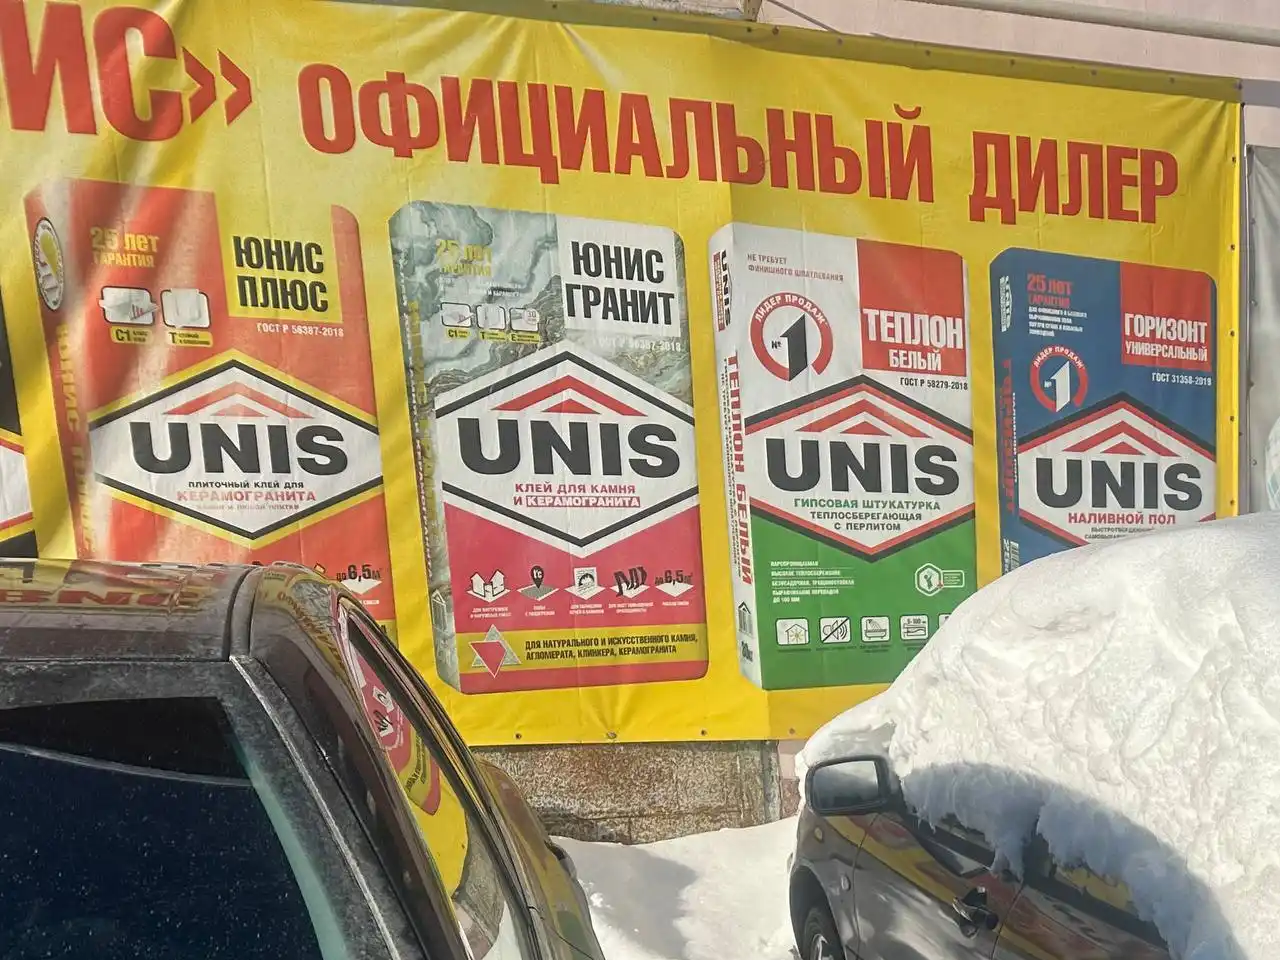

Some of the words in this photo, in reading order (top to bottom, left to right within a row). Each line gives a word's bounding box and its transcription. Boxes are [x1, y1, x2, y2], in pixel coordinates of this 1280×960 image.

[298, 63, 934, 203] ОФИЦИАЛЬНЫЙ
[968, 130, 1179, 225] ДИЛЕР
[232, 235, 325, 274] ЮНИС
[571, 241, 665, 283] ЮНИС
[758, 255, 787, 265] ТРЕБУЕТ
[748, 264, 793, 275] ФИНИШНОГО
[237, 276, 329, 312] ПЛЮС
[565, 283, 676, 325] ГРАНИТ
[754, 295, 781, 322] ЛИДЕР
[785, 294, 827, 325] ПРОДАЖ
[256, 322, 281, 334] ГОСТ
[862, 308, 964, 349] ТЕПЛОН
[1124, 313, 1208, 344] ГОРИЗОНТ
[889, 348, 942, 371] БЕЛЫЙ
[1033, 347, 1053, 368] ЛИДЕР
[1125, 341, 1208, 362] УНИВЕРСАЛЬНЫЙ
[900, 377, 918, 386] ГОСТ
[1151, 372, 1170, 383] ГОСТ
[728, 352, 745, 472] ТЕПЛОН
[129, 421, 348, 476] UNIS
[458, 418, 681, 478] UNIS
[766, 438, 959, 496] UNIS
[188, 480, 250, 489] ПЛИТОЧНЫЙ
[254, 480, 280, 489] КЛЕЙ
[284, 481, 304, 489] ДЛЯ
[515, 481, 553, 494] КЛЕЙ
[557, 483, 587, 495] ДЛЯ
[591, 484, 636, 494] КАМНЯ
[1036, 457, 1203, 511] UNIS
[177, 490, 317, 502] КЕРАМОГРАНИТА
[513, 496, 523, 506] И
[527, 496, 640, 507] КЕРАМОГРАНИТА
[794, 498, 859, 509] ГИПСОВАЯ
[862, 500, 941, 511] ШТУКАТУРКА
[810, 511, 922, 522] ТЕПЛОСБЕРЕГАЮЩАЯ
[834, 522, 841, 530] С
[846, 522, 901, 531] ПЕРЛИТОМ
[1068, 511, 1144, 525] НАЛИВНОЙ
[1149, 513, 1176, 525] ПОЛ
[736, 484, 753, 585] БЕЛЫЙ
[347, 565, 372, 582] 6,5
[525, 641, 540, 651] ДЛЯ
[543, 638, 599, 649] НАТУРАЛЬНОГО
[619, 645, 677, 656] КЕРАМОГРАНИТА
